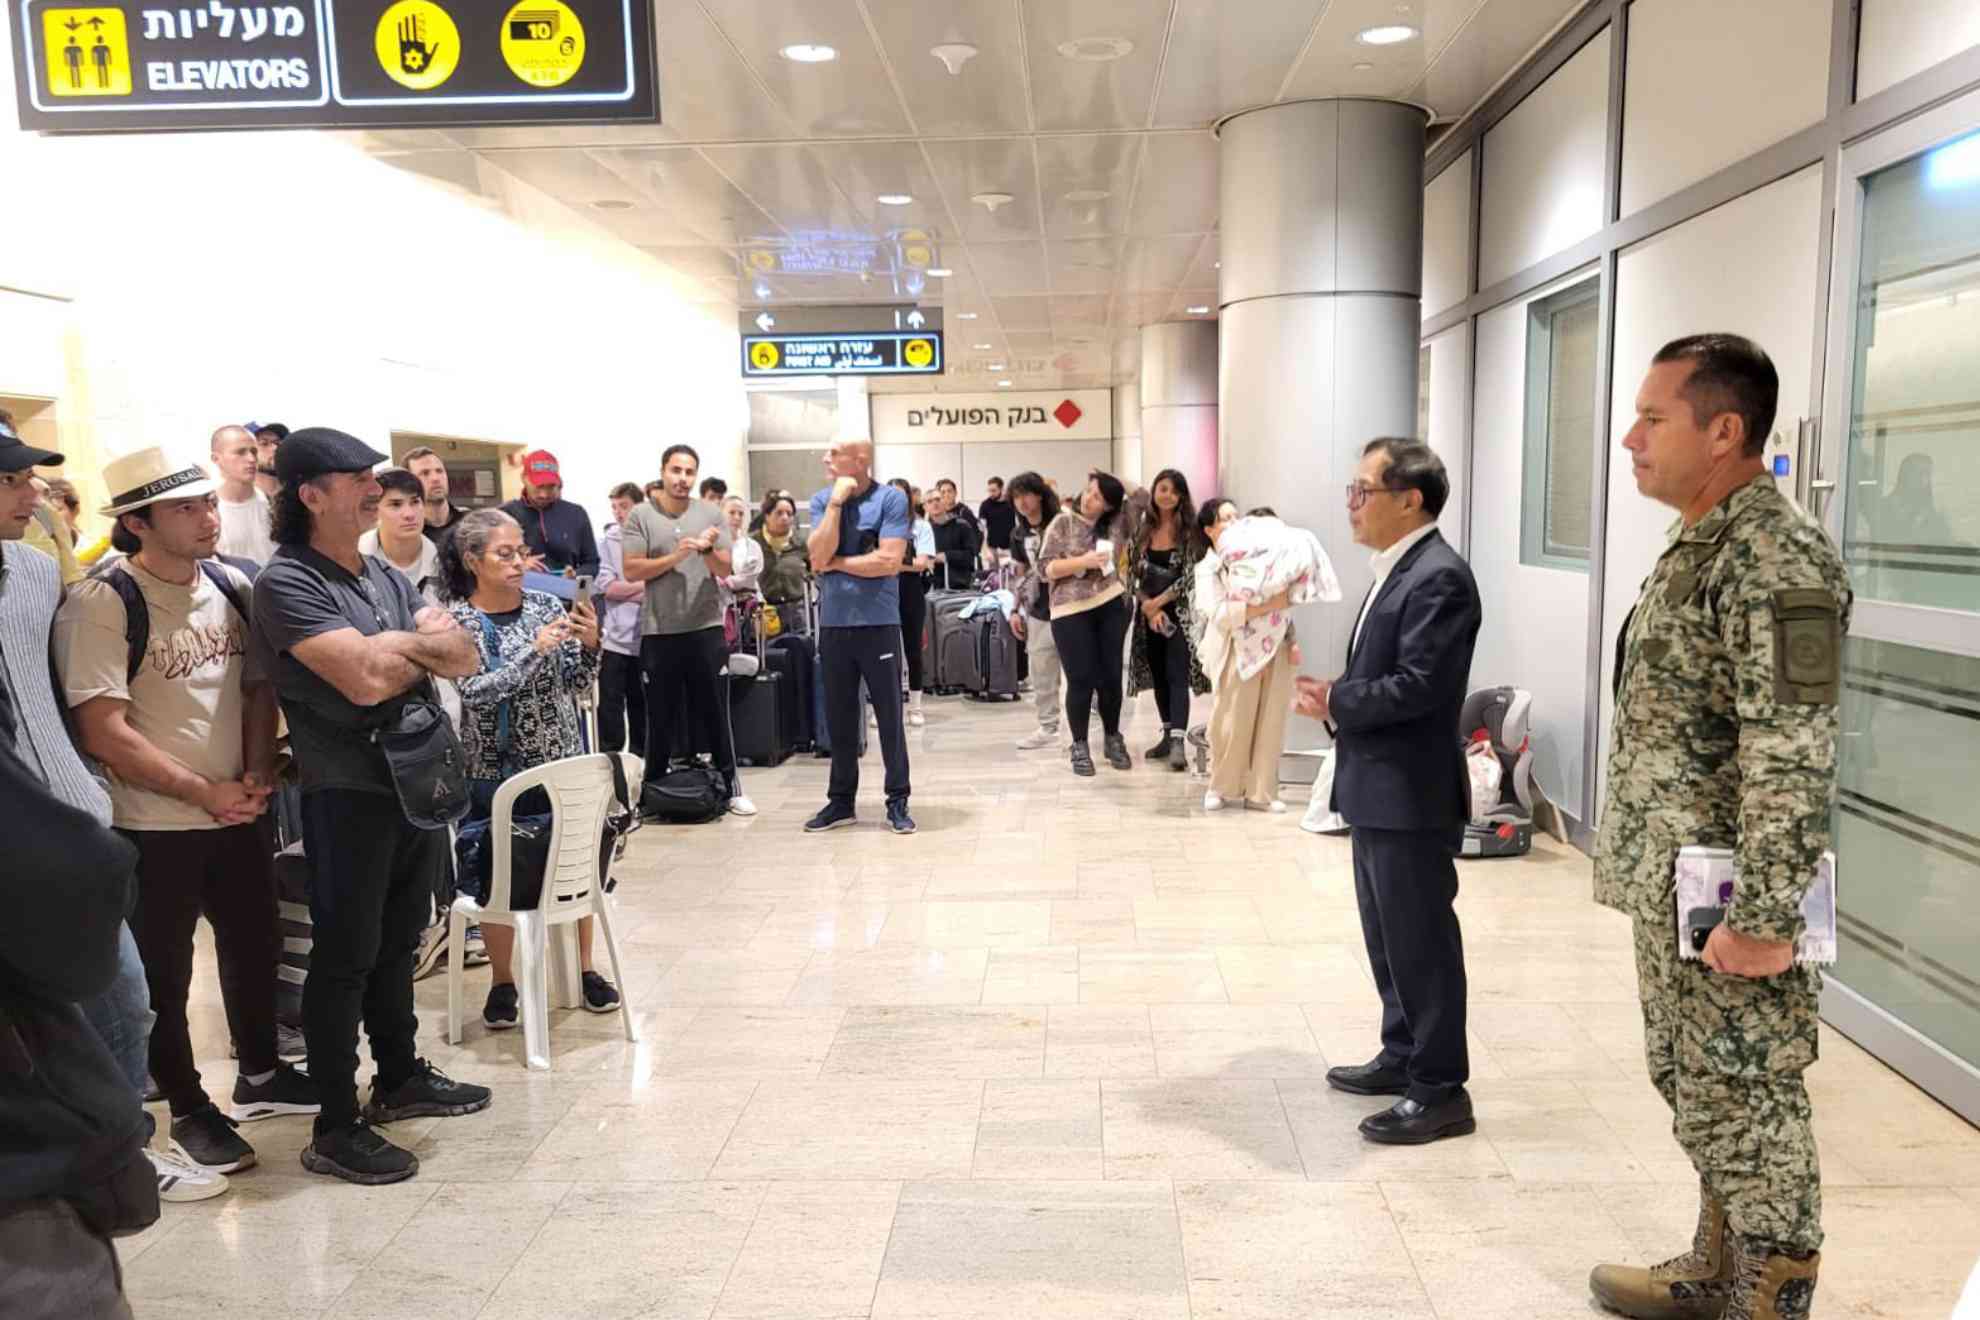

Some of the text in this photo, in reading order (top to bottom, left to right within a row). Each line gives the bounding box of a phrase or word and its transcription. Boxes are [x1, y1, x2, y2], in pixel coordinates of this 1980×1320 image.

[142, 1, 305, 41] מעליות
[147, 58, 310, 91] ELEVATORS
[908, 405, 1048, 428] בנק הפועלים
